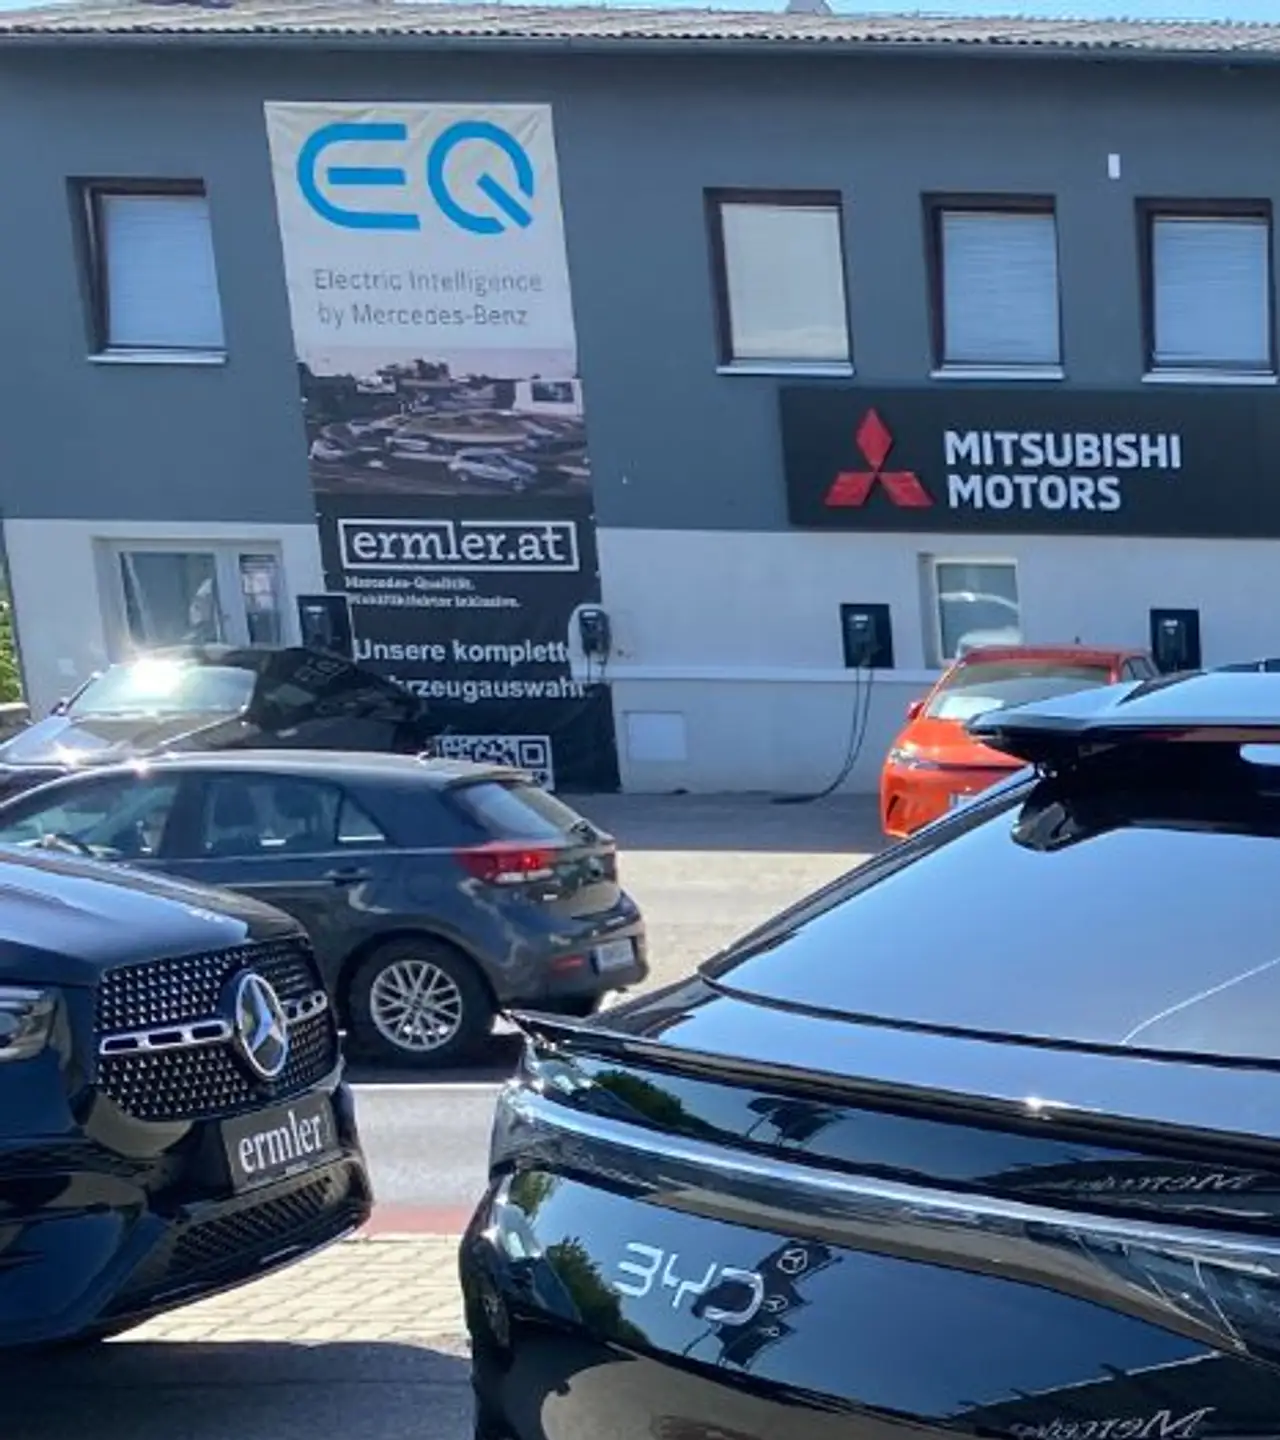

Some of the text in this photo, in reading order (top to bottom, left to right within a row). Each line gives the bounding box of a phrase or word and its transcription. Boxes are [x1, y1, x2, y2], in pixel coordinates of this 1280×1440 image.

[296, 120, 534, 234] EQ
[313, 268, 543, 297] Electric Intelligence
[318, 301, 529, 329] by Mercedes-Benz
[944, 430, 1181, 469] MITSUBISHI
[948, 474, 1121, 511] MOTORS
[353, 522, 566, 562] ermler.at
[353, 638, 567, 667] Unsere komplett
[238, 1109, 322, 1174] ermler
